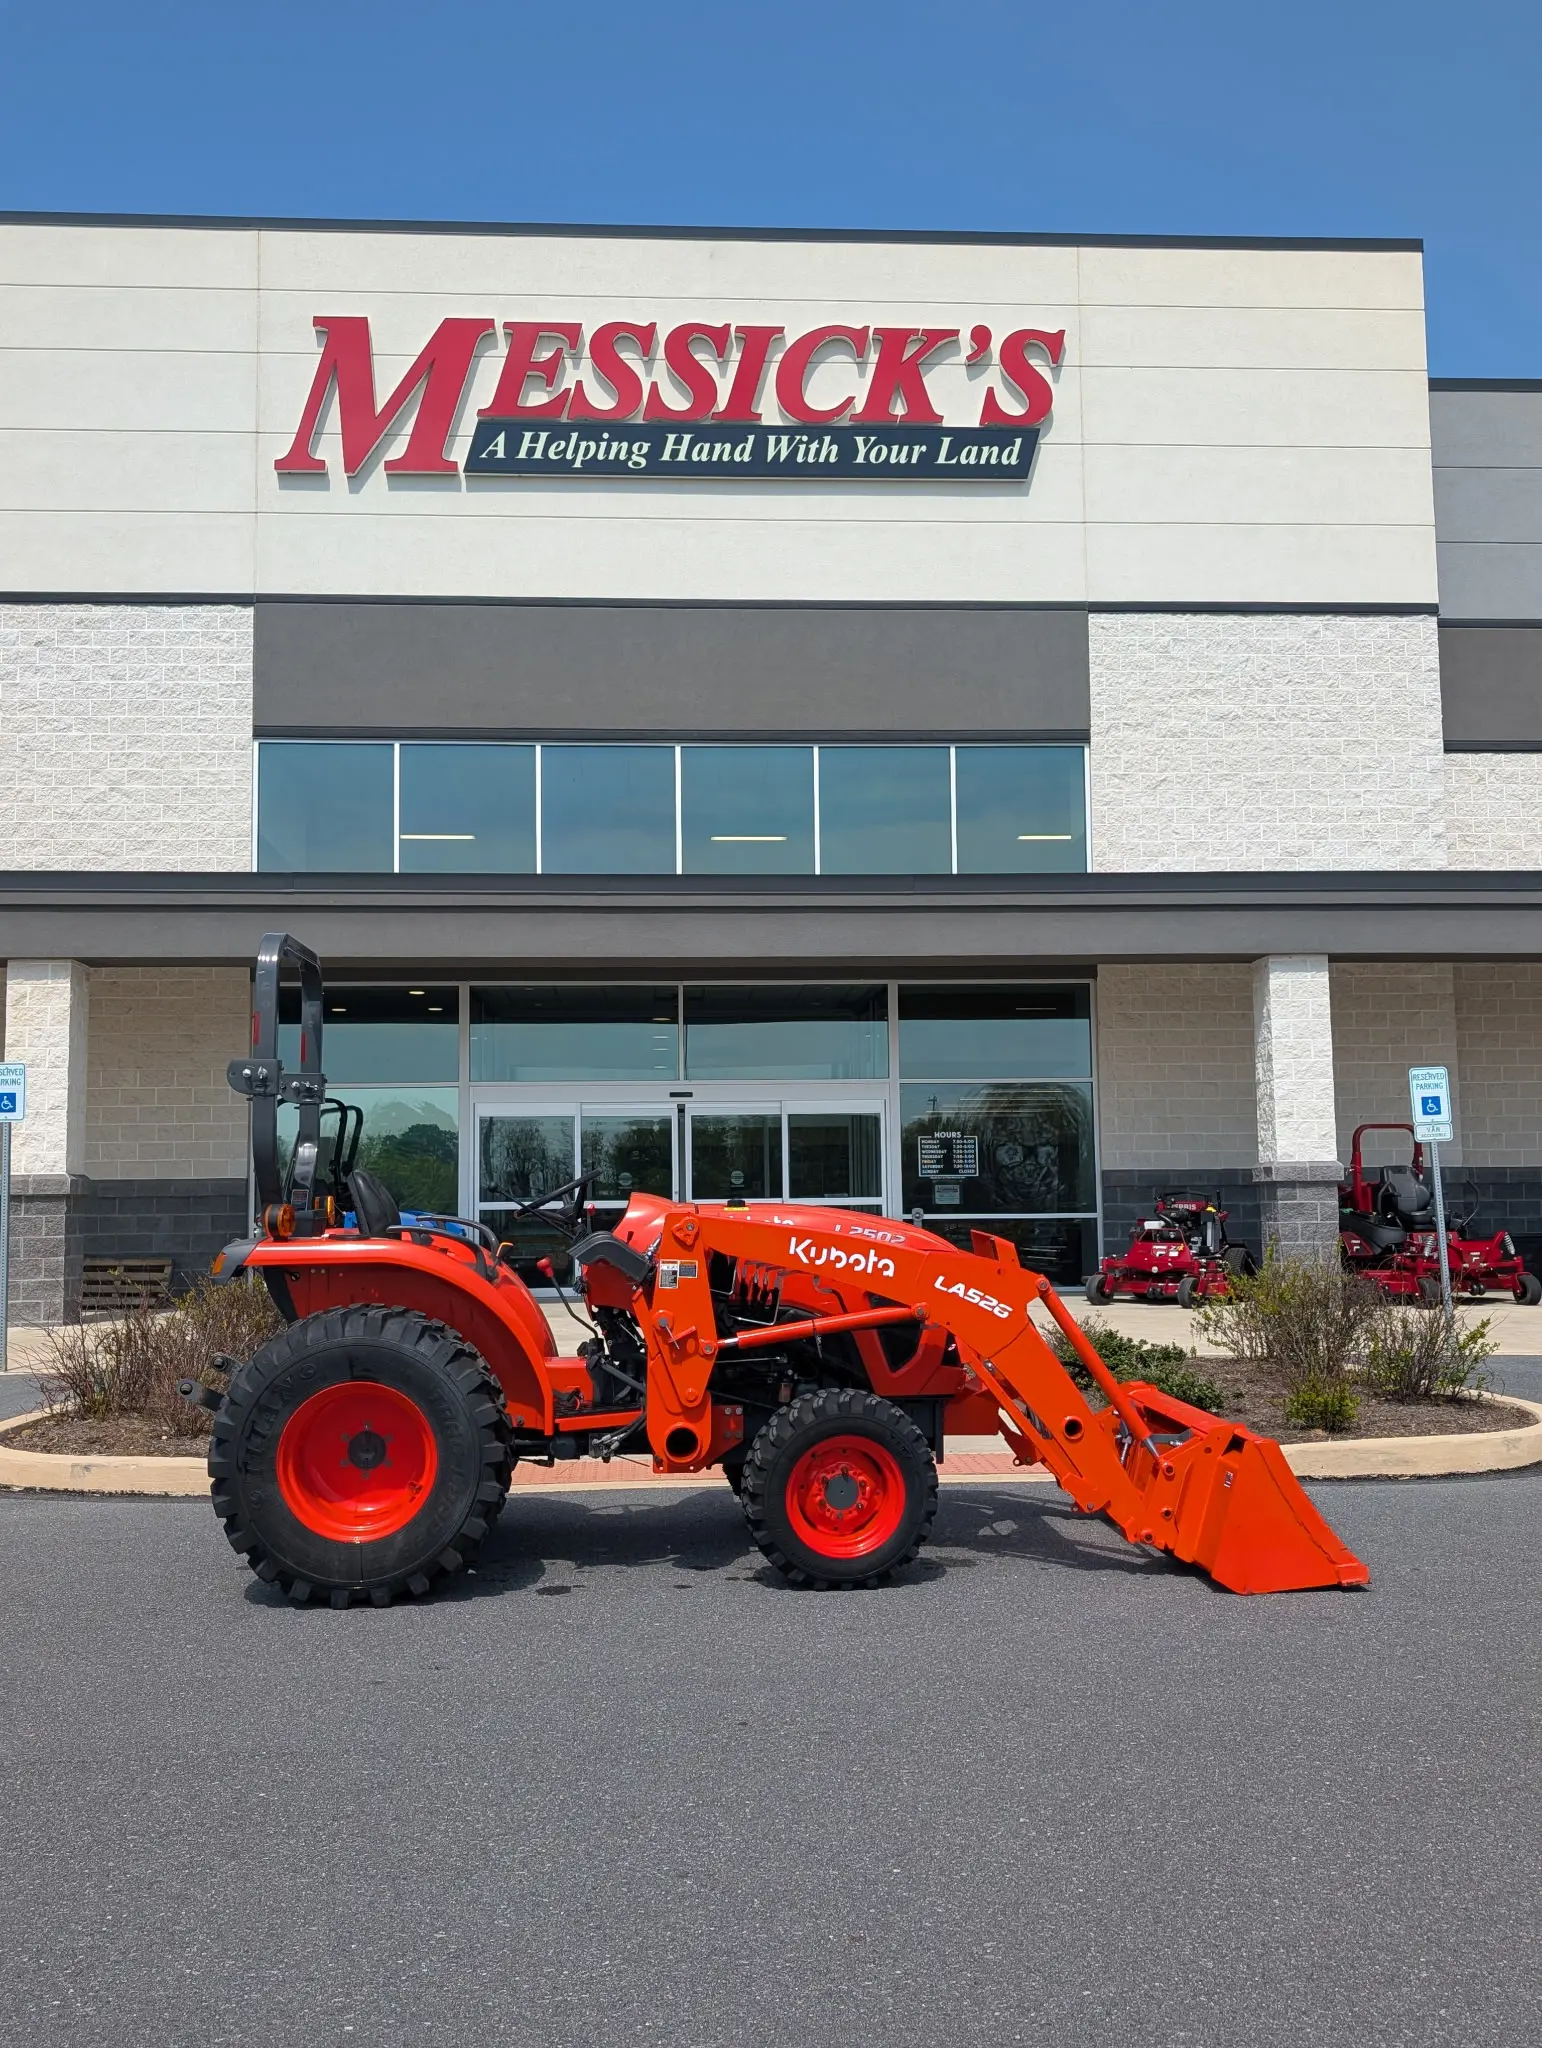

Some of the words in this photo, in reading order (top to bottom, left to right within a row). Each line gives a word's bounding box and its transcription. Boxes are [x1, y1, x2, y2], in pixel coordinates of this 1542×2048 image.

[274, 316, 1065, 475] MESSICK'S
[479, 430, 507, 459] A
[515, 431, 652, 469] Helping
[658, 433, 756, 463] Hand
[766, 435, 839, 464] With
[853, 436, 927, 464] Your
[934, 436, 1023, 466] Land
[0, 1068, 24, 1076] SERVED
[0, 1078, 21, 1086] RKING
[1412, 1072, 1445, 1081] RESERVED
[1415, 1082, 1444, 1090] PARKING
[788, 1236, 895, 1278] Kubota
[934, 1275, 1013, 1319] LA526
